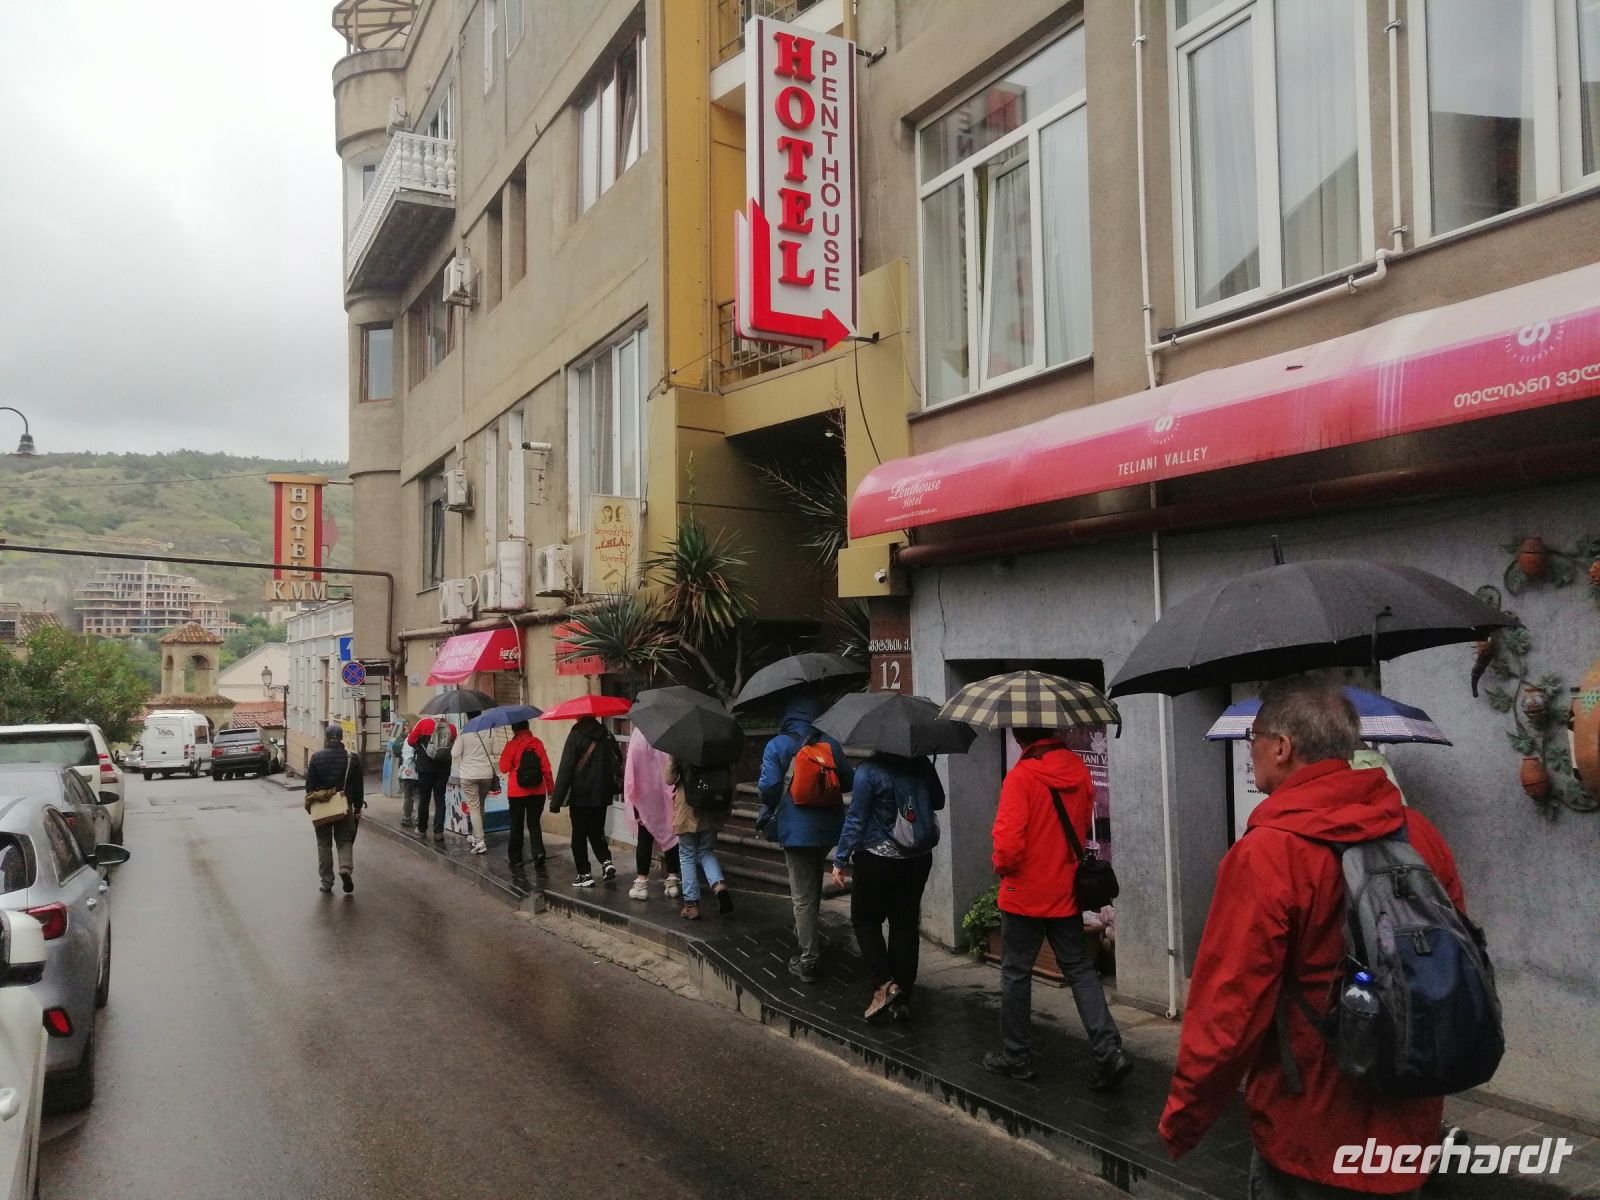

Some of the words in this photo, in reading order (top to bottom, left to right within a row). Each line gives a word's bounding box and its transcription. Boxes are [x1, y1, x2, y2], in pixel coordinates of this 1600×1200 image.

[773, 31, 816, 289] HOTEL
[821, 49, 841, 292] PENTHOUSE
[1454, 375, 1551, 408] თელიანი
[1118, 456, 1157, 476] TELIANI
[1164, 446, 1208, 466] VALLEY
[888, 479, 941, 501] Penthouse
[902, 493, 925, 508] Hotel
[289, 487, 308, 577] HOTEL
[270, 581, 327, 601] KMM
[880, 660, 901, 690] 12
